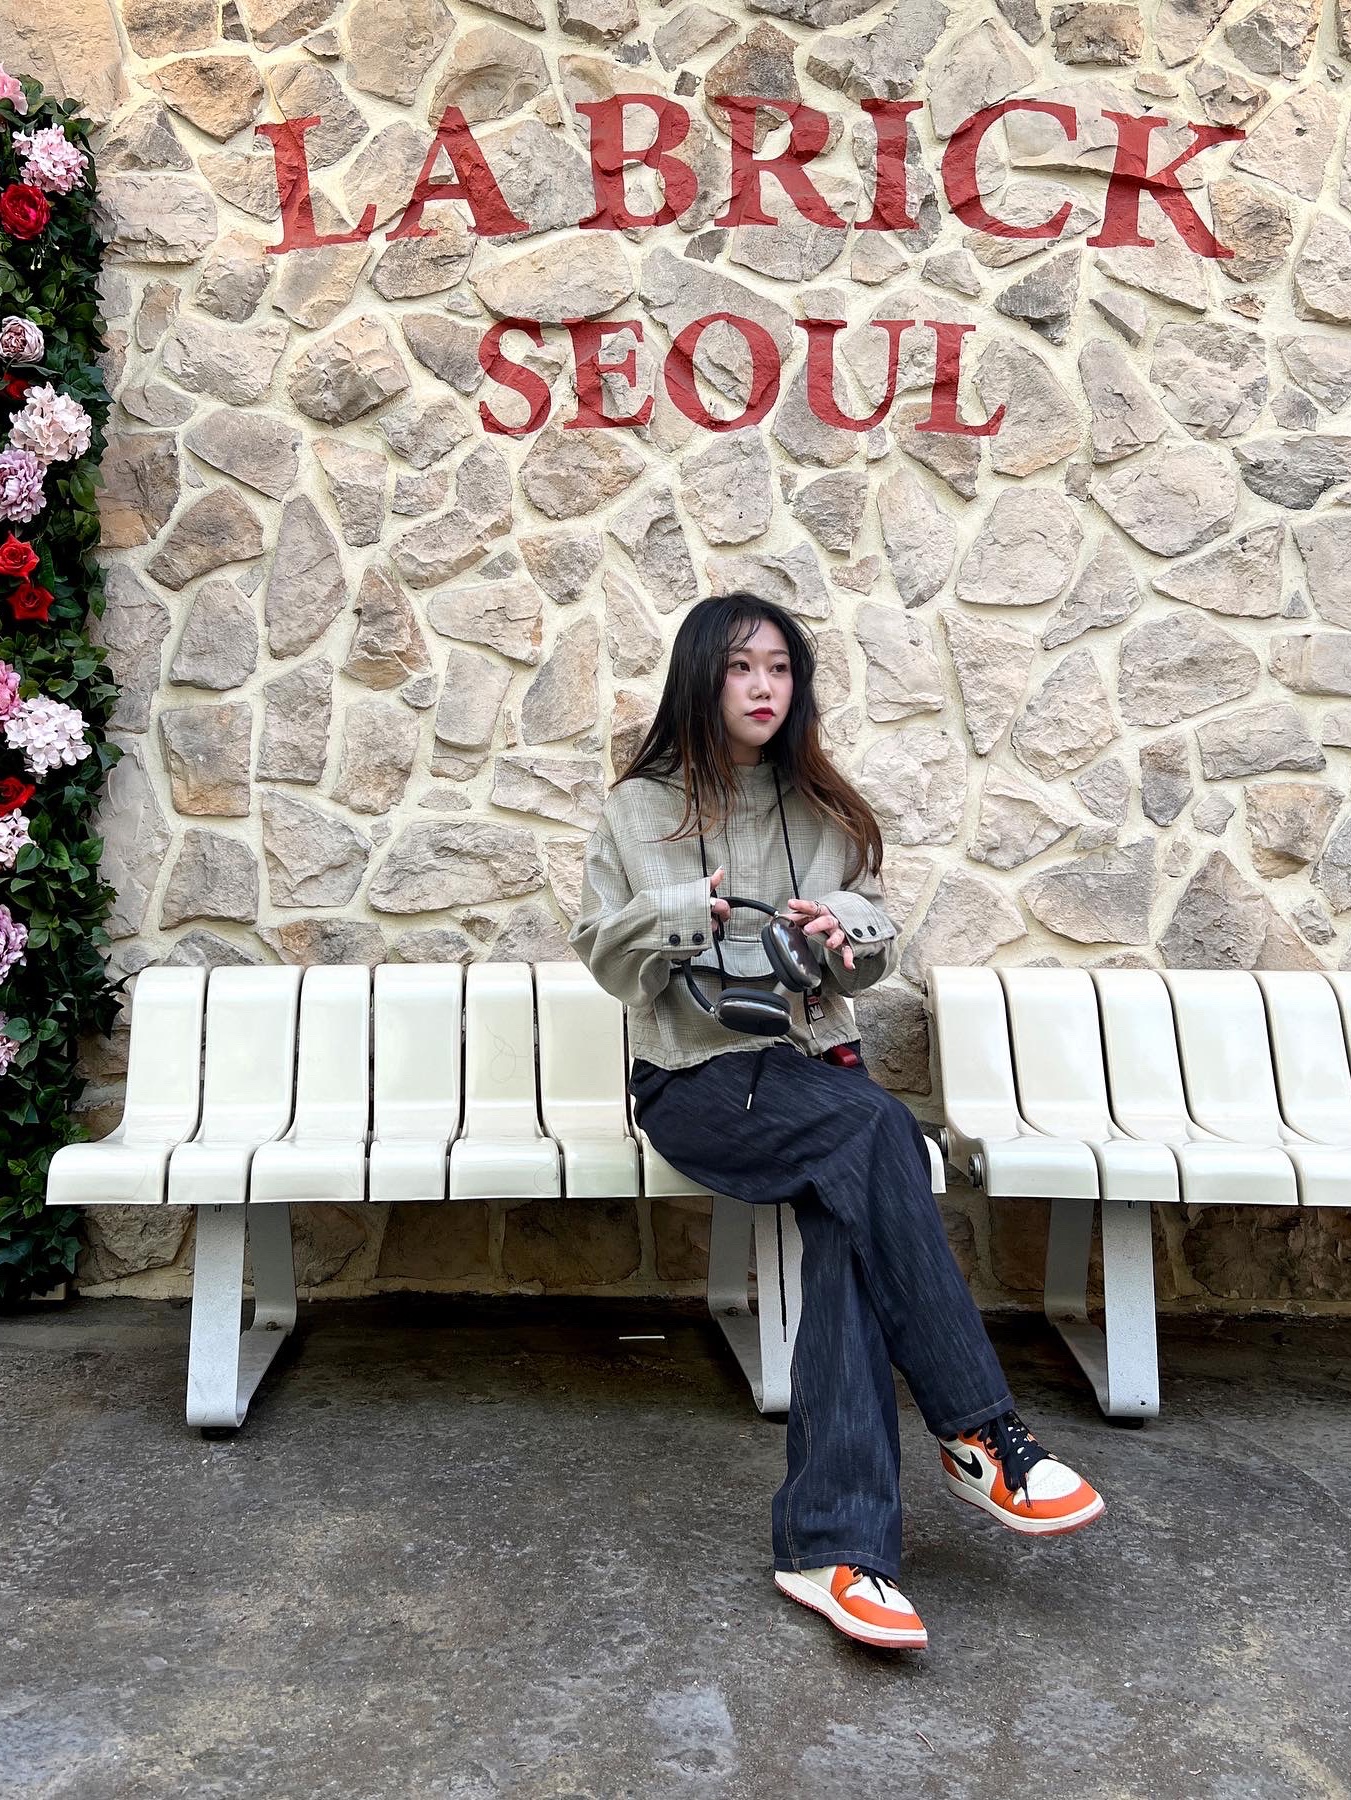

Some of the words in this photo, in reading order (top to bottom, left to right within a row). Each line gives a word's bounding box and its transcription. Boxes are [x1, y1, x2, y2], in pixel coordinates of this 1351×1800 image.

[255, 106, 530, 254] LA
[576, 93, 1246, 259] BRICK
[478, 312, 1005, 437] SEOUL
